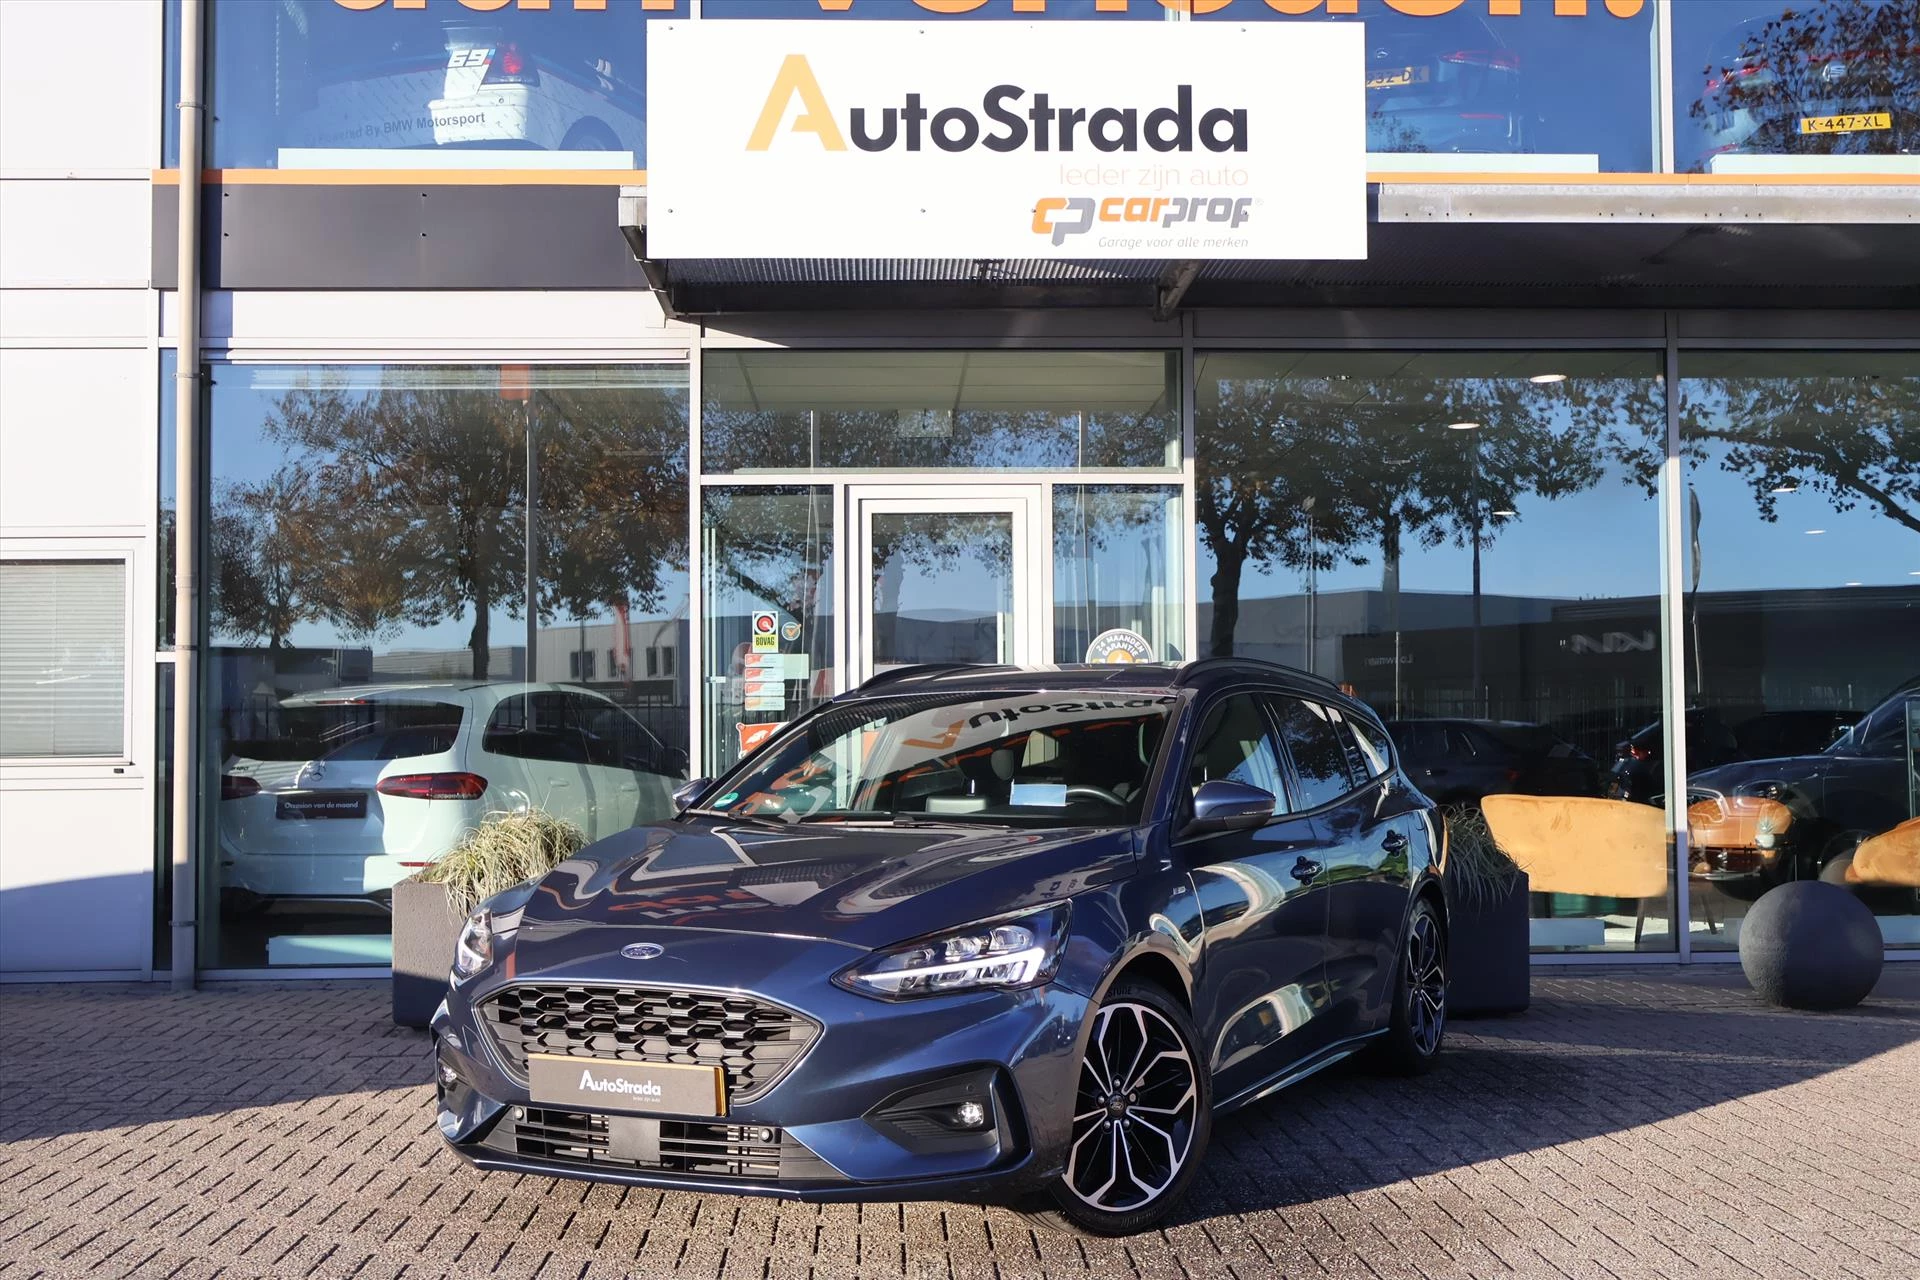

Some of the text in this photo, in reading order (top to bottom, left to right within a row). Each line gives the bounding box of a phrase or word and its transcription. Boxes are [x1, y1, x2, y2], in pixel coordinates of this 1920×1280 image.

[447, 48, 490, 68] 69
[745, 54, 1248, 153] AutoStrada
[366, 124, 380, 138] By
[383, 118, 413, 134] BMW
[416, 112, 485, 129] Motorsport
[1807, 116, 1883, 131] K-447-XL
[1060, 164, 1249, 191] Ieder zijn auto
[1098, 197, 1253, 229] carprof
[1098, 236, 1249, 249] Garage voor alle merken
[755, 636, 775, 646] BOVAG
[1096, 634, 1145, 653] 24 MAANDEN
[1102, 642, 1139, 657] GARANTIE
[579, 1069, 662, 1096] AutoStrada
